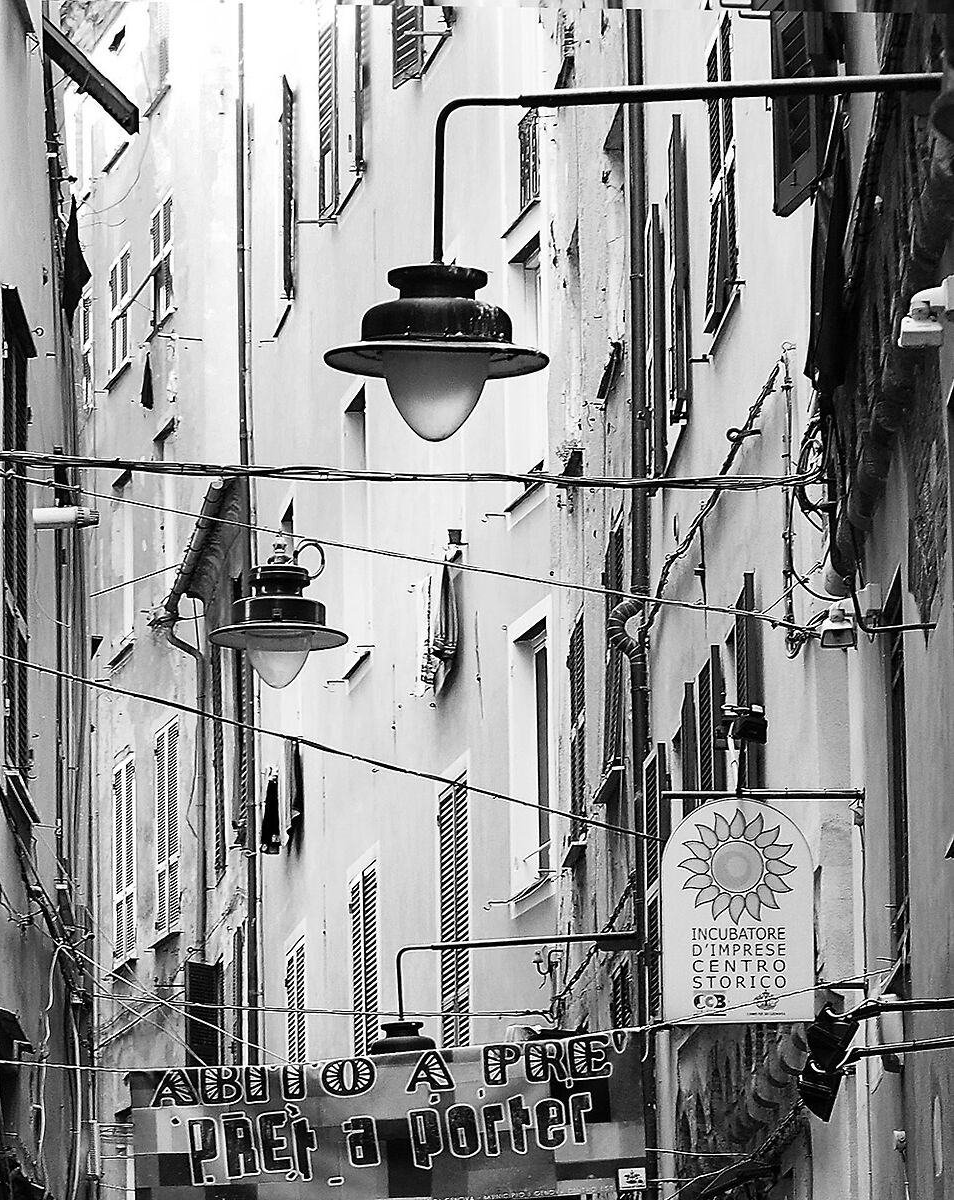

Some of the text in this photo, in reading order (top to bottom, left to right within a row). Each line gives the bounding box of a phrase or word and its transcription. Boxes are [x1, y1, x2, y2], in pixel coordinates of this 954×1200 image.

[691, 927, 786, 941] INCUBATORE
[692, 943, 786, 957] D'IMPRESE
[692, 959, 786, 973] CENTRO
[692, 975, 787, 989] STORICO
[150, 1057, 378, 1109] ABITO
[405, 1050, 456, 1093] A
[342, 1115, 381, 1168] a
[407, 1093, 593, 1170] porter
